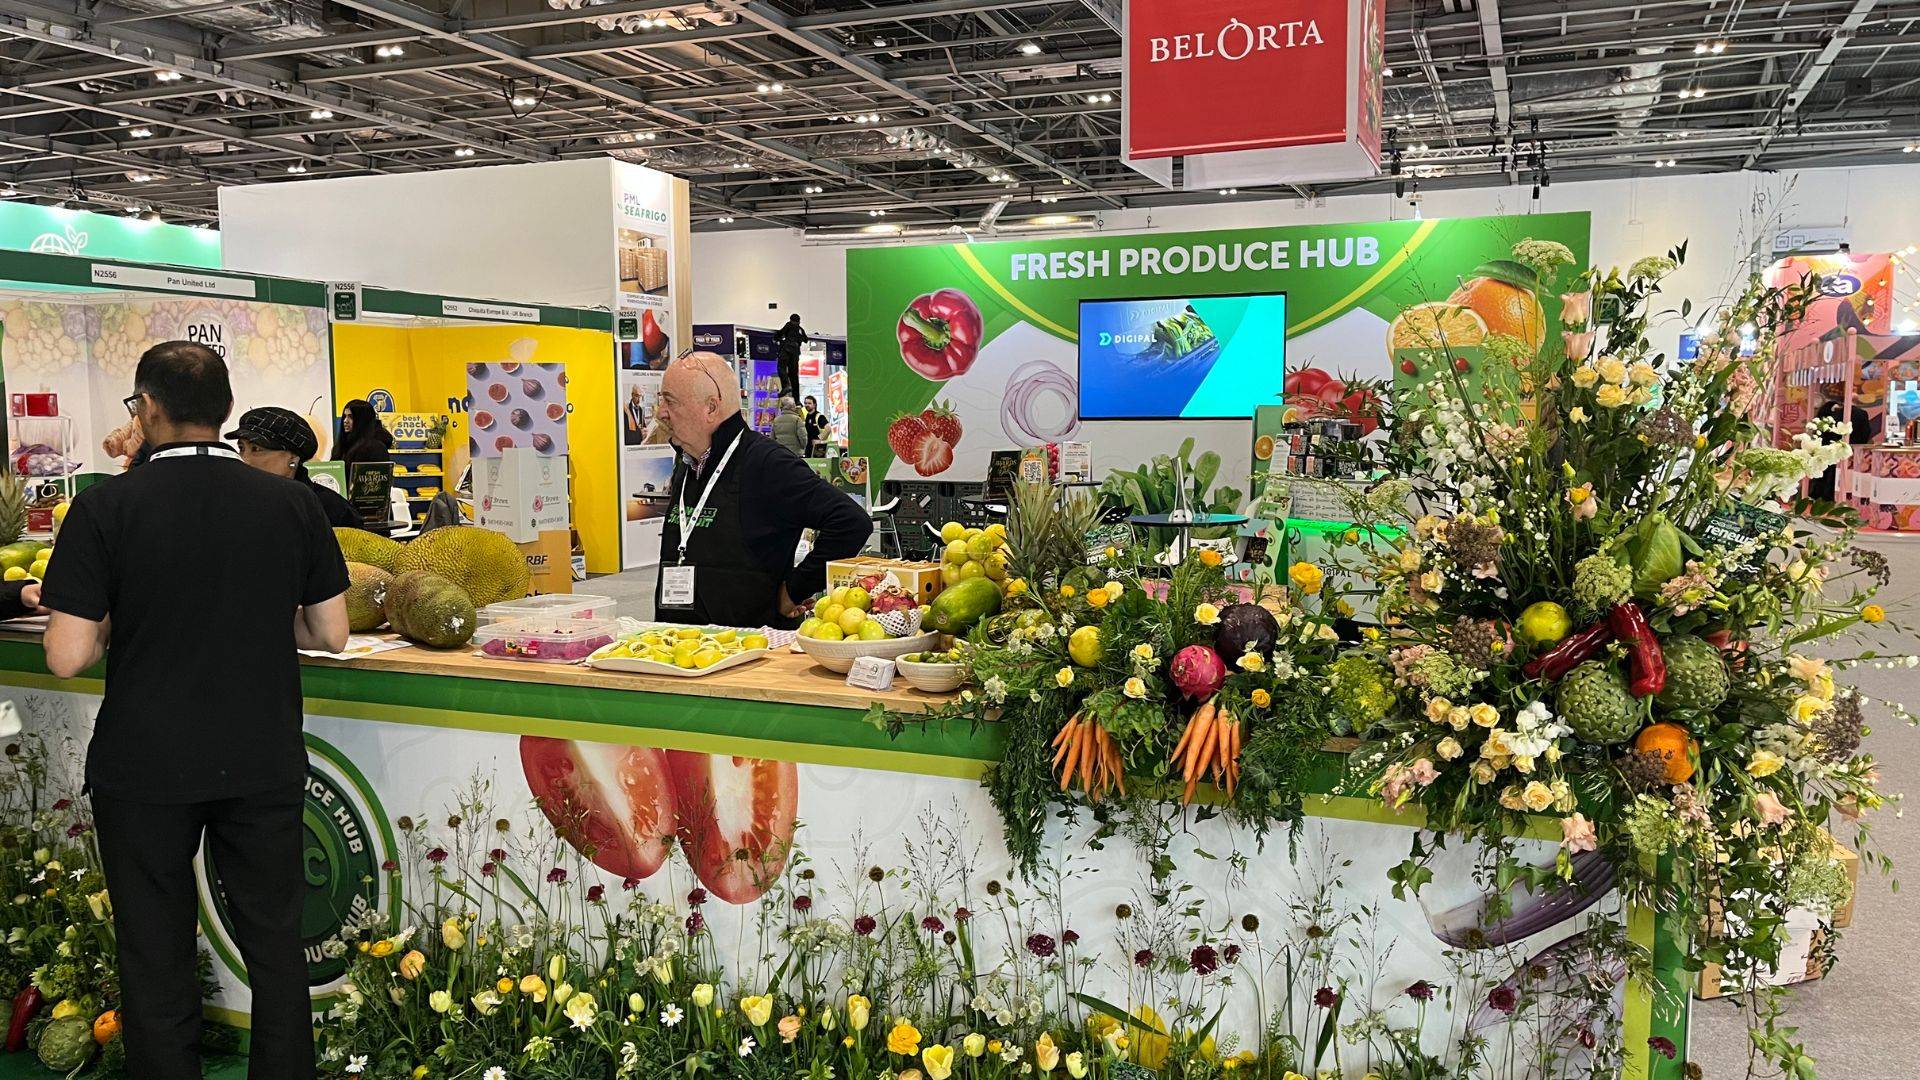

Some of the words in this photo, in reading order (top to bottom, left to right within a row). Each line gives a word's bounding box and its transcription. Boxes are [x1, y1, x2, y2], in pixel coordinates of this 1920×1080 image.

[624, 193, 640, 206] PML
[624, 205, 667, 222] SEAFRIGO
[1011, 249, 1109, 281] FRESH
[1119, 240, 1290, 276] PRODUCE
[1299, 236, 1380, 269] HUB
[94, 269, 117, 279] N2556
[167, 277, 180, 286] Pan
[181, 278, 202, 288] United
[204, 280, 216, 289] Ltd
[334, 283, 355, 291] N2556
[188, 324, 222, 343] PAN
[1114, 333, 1158, 344] DIGIPAL
[402, 414, 420, 422] best
[397, 420, 427, 429] snack
[394, 427, 432, 438] ever
[526, 555, 548, 566] RBF
[333, 806, 364, 854] HUB
